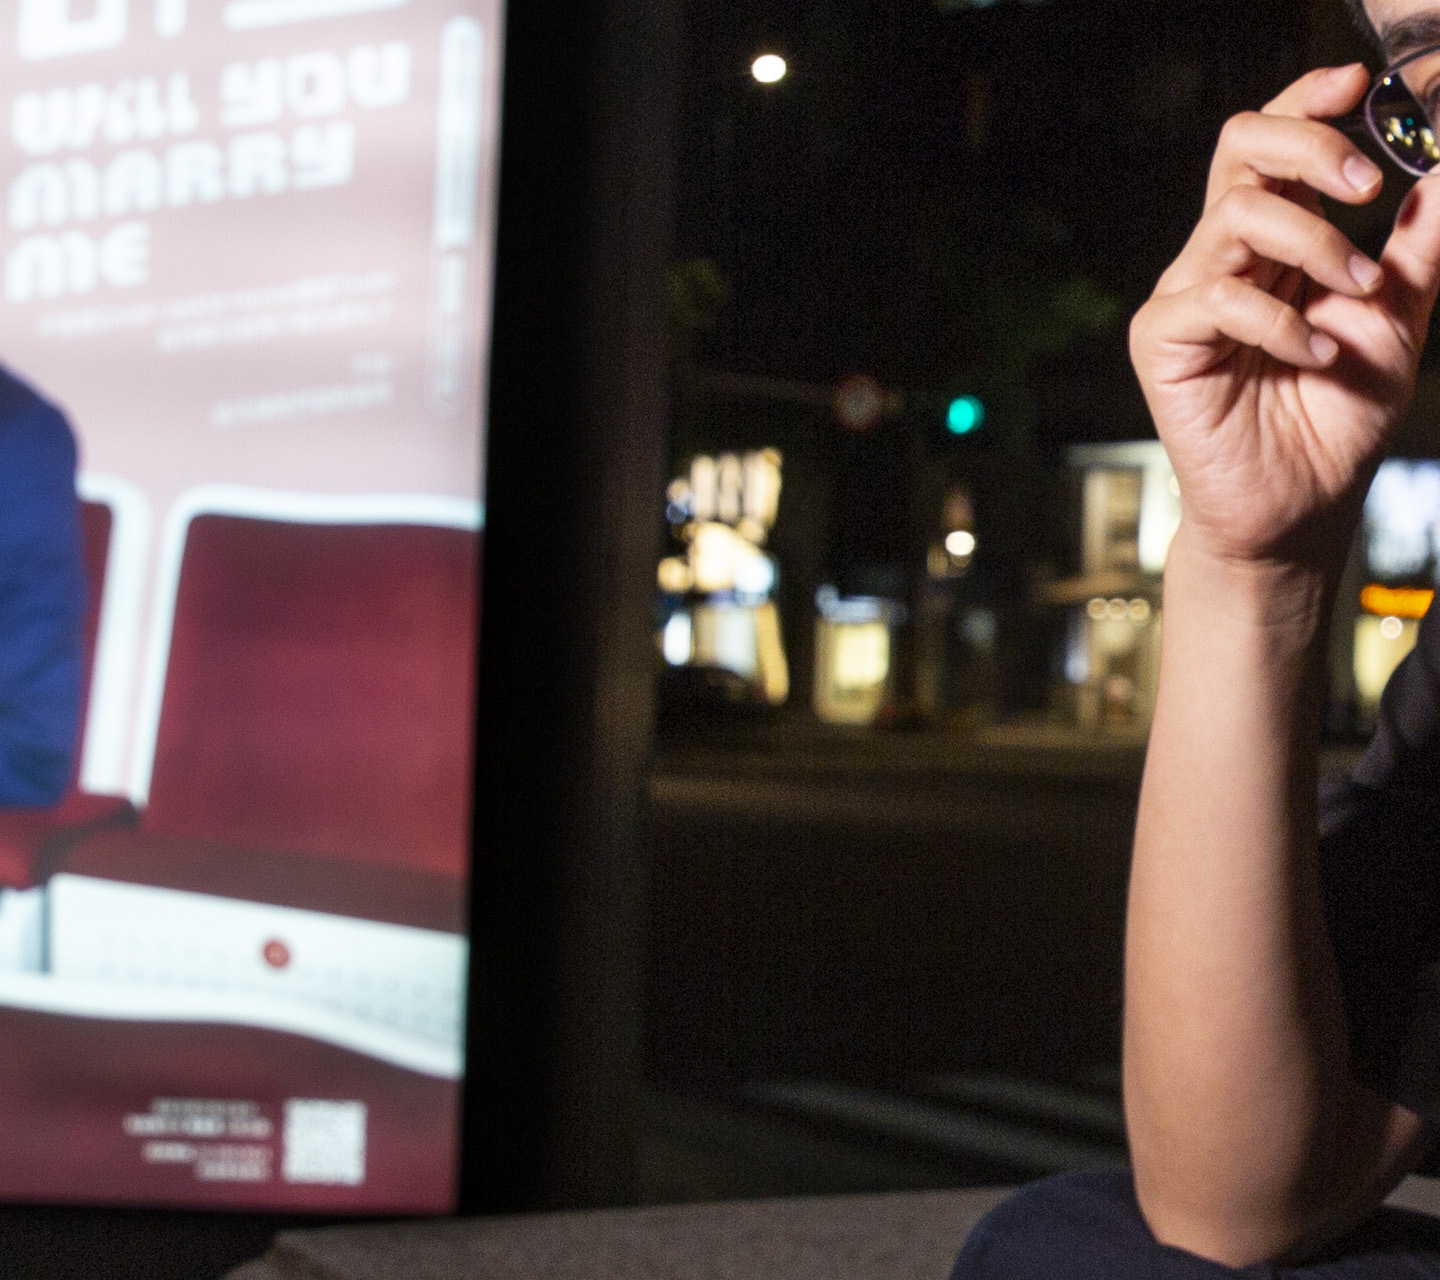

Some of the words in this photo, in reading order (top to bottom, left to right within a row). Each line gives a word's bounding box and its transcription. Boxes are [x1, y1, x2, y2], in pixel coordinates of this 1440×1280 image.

[218, 39, 412, 127] YOU
[7, 121, 356, 231] MARRY
[3, 220, 152, 303] ME
